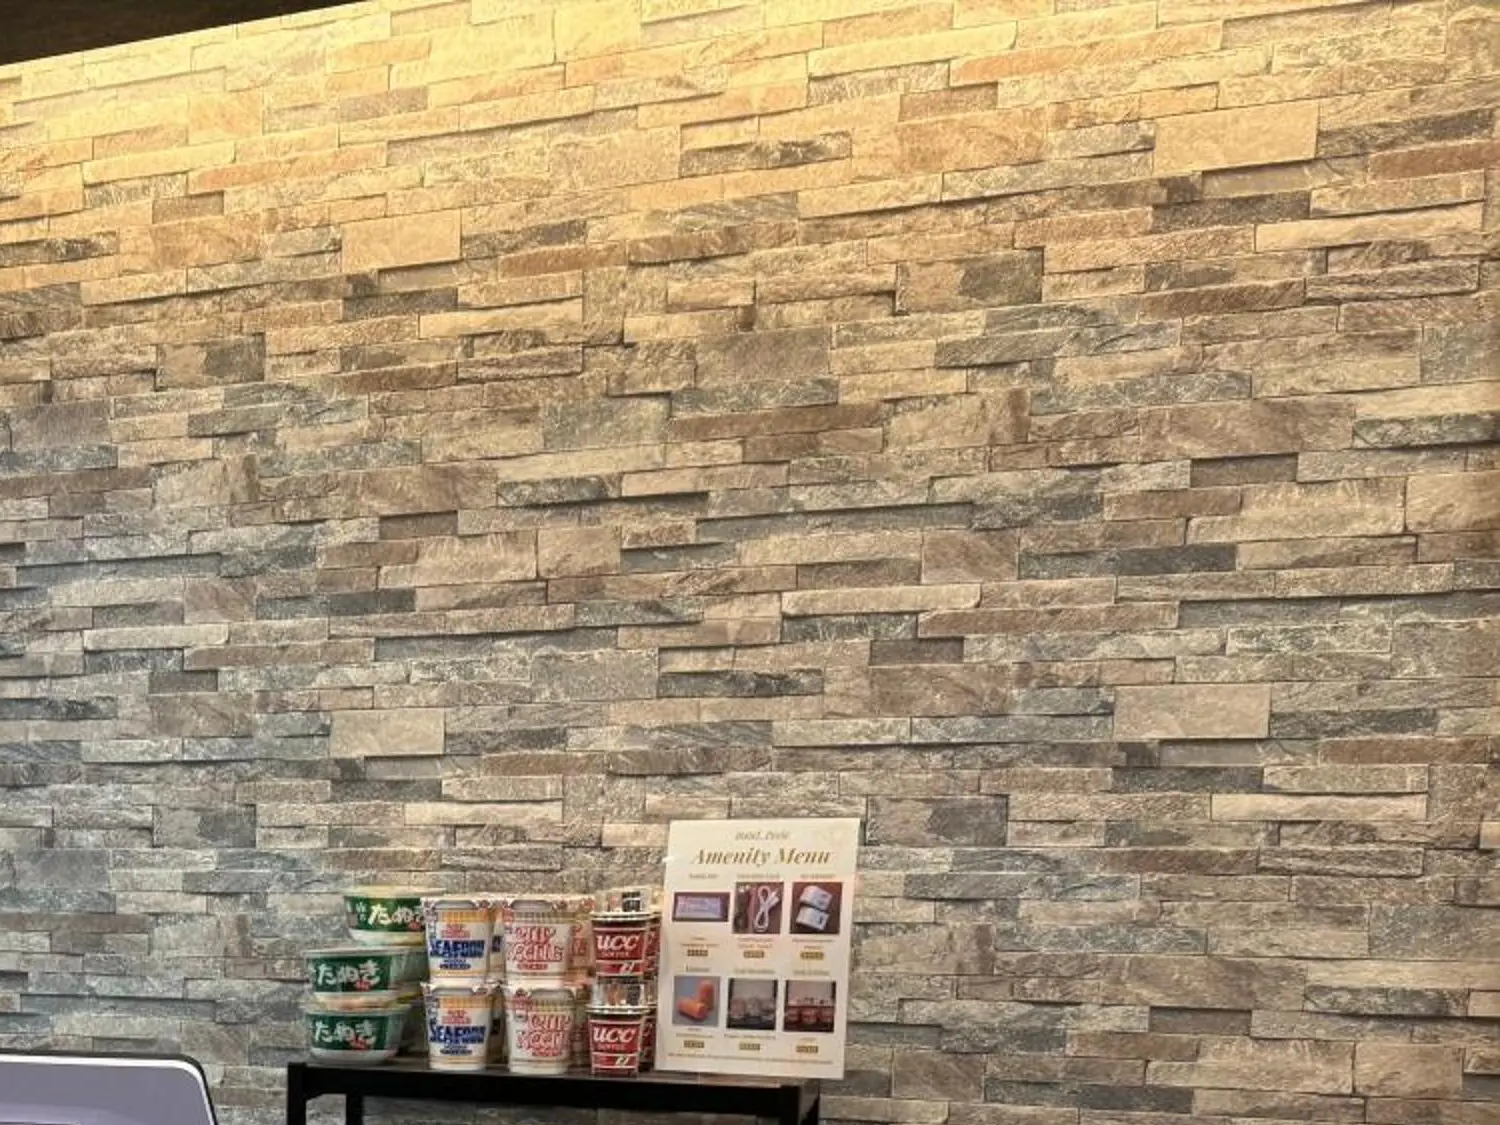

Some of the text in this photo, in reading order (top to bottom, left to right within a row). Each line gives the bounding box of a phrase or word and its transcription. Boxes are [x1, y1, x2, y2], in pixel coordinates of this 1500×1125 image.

[690, 847, 832, 867] Amenity Menu
[316, 959, 381, 987] たぬき
[314, 1018, 378, 1045] たぬき
